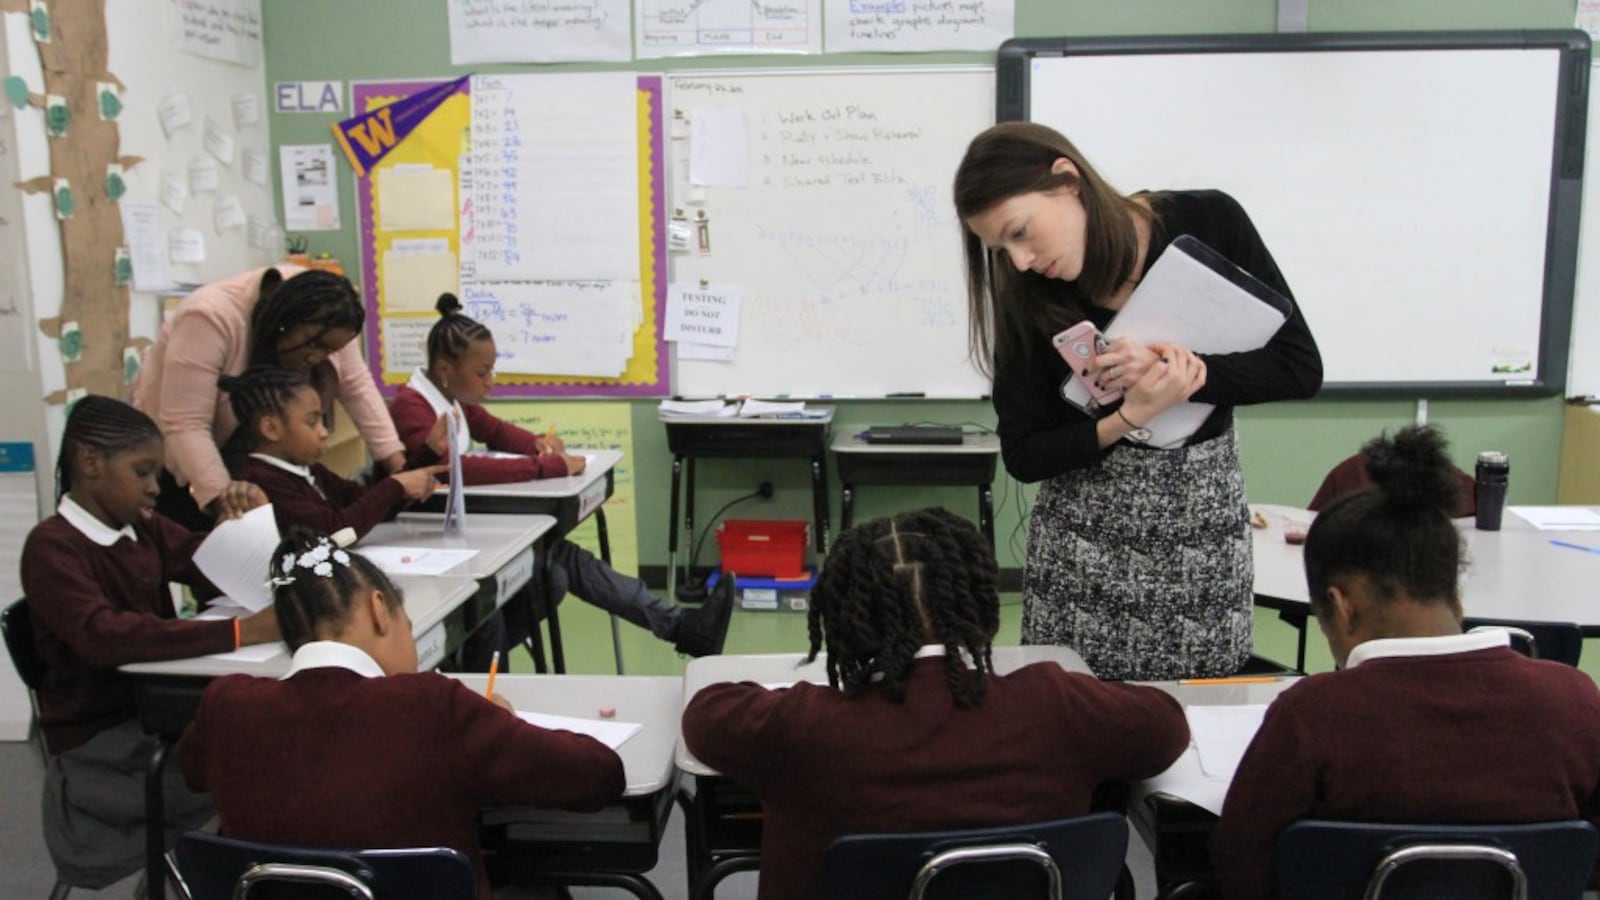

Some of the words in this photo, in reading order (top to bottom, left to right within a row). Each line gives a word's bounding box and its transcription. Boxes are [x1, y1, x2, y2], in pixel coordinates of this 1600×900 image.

[277, 83, 339, 111] ELA
[349, 107, 398, 156] W
[682, 292, 727, 305] TESTING
[684, 308, 700, 319] DO
[701, 309, 721, 320] NOT
[680, 323, 723, 336] DISTURB
